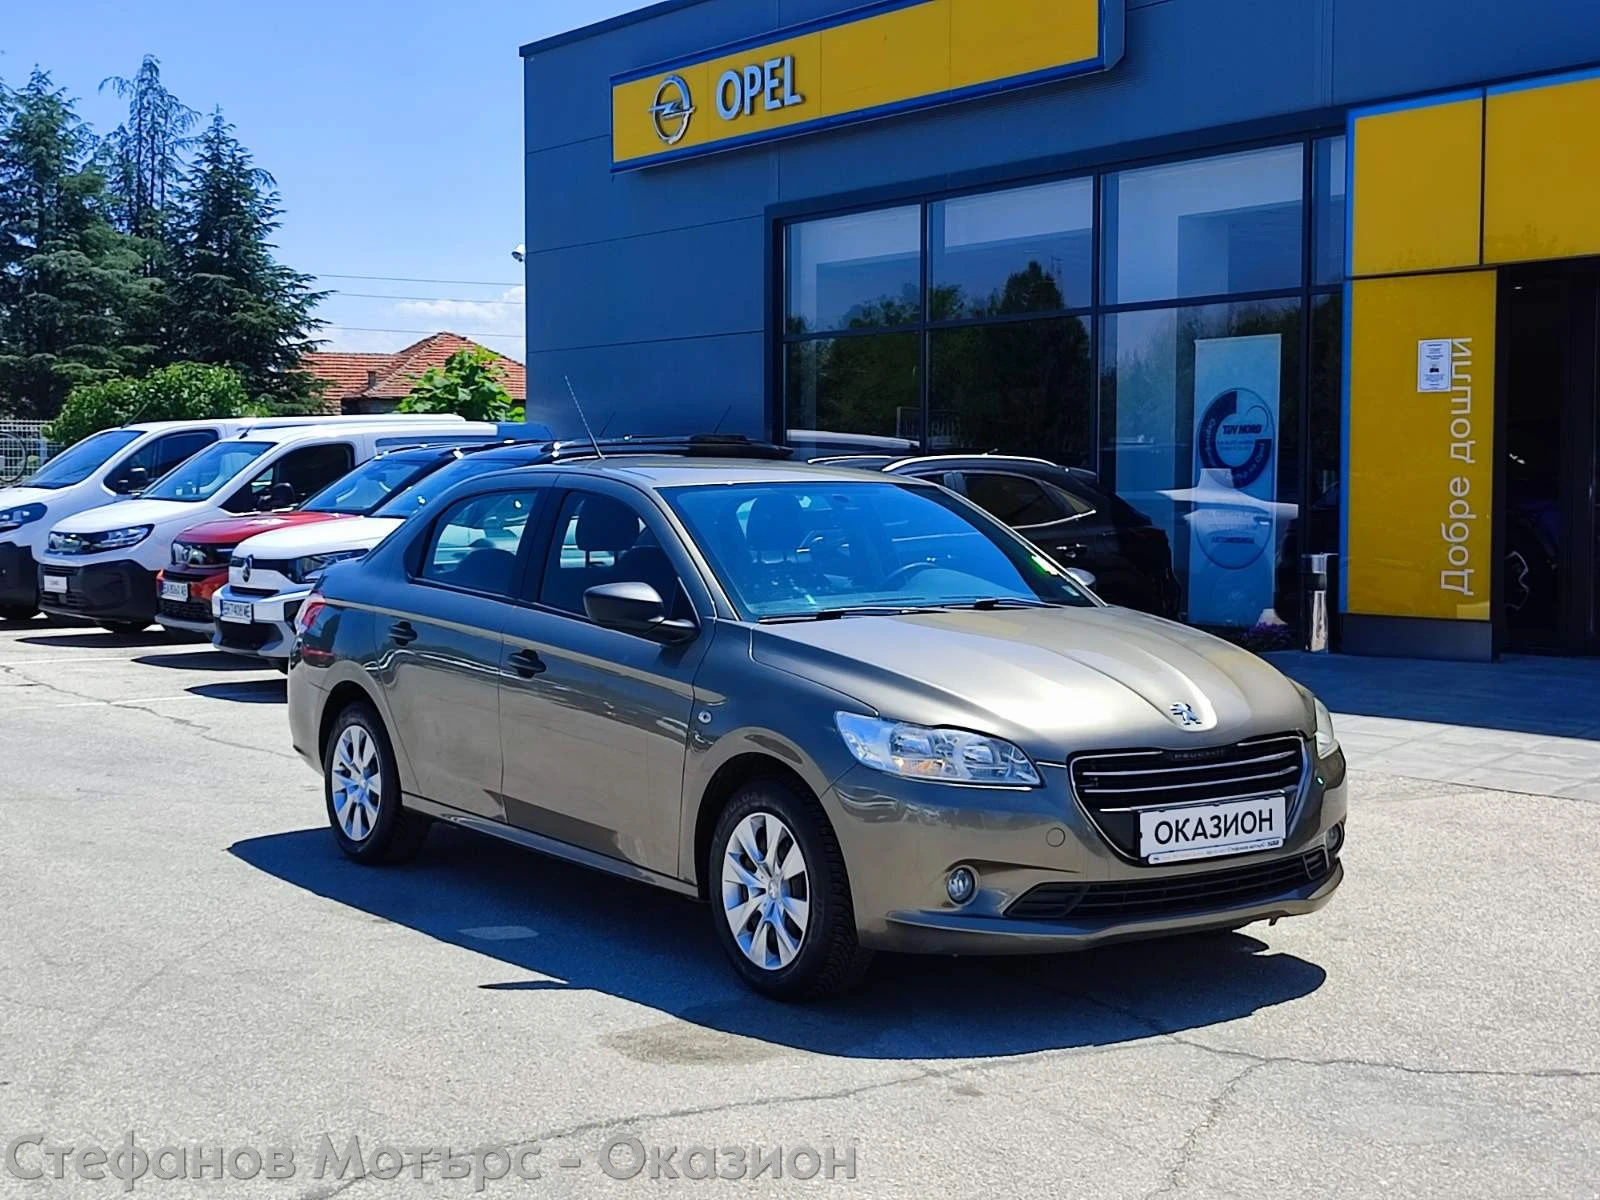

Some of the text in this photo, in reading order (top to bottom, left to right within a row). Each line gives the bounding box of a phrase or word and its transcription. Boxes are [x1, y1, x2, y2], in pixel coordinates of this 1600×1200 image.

[715, 55, 803, 121] OPEL
[1440, 337, 1476, 596] Добре дошли
[1154, 808, 1273, 845] ОКАЗИОН
